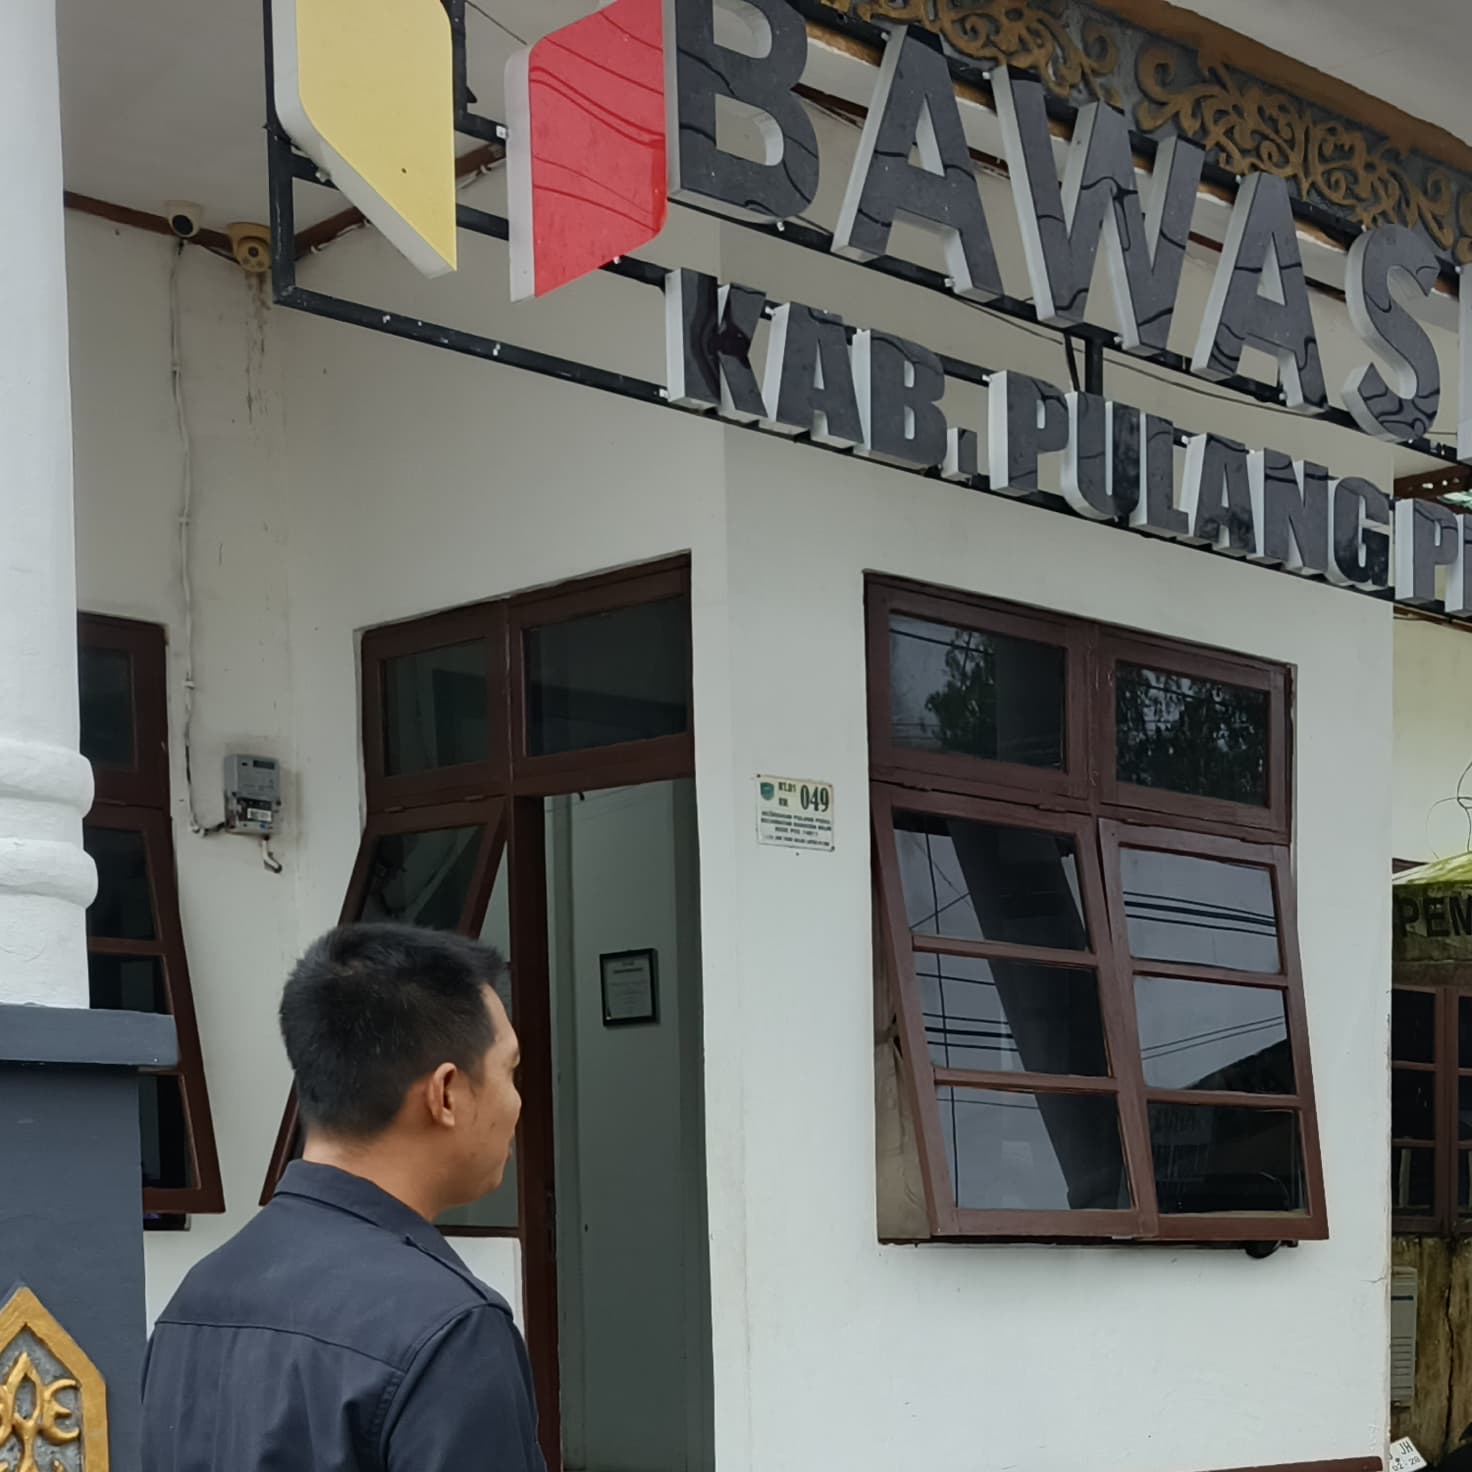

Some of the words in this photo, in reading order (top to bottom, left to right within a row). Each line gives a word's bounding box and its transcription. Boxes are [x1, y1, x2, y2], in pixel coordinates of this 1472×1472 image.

[665, 267, 979, 482] KAB.
[988, 370, 1391, 592] PULANG
[800, 784, 829, 812] 049
